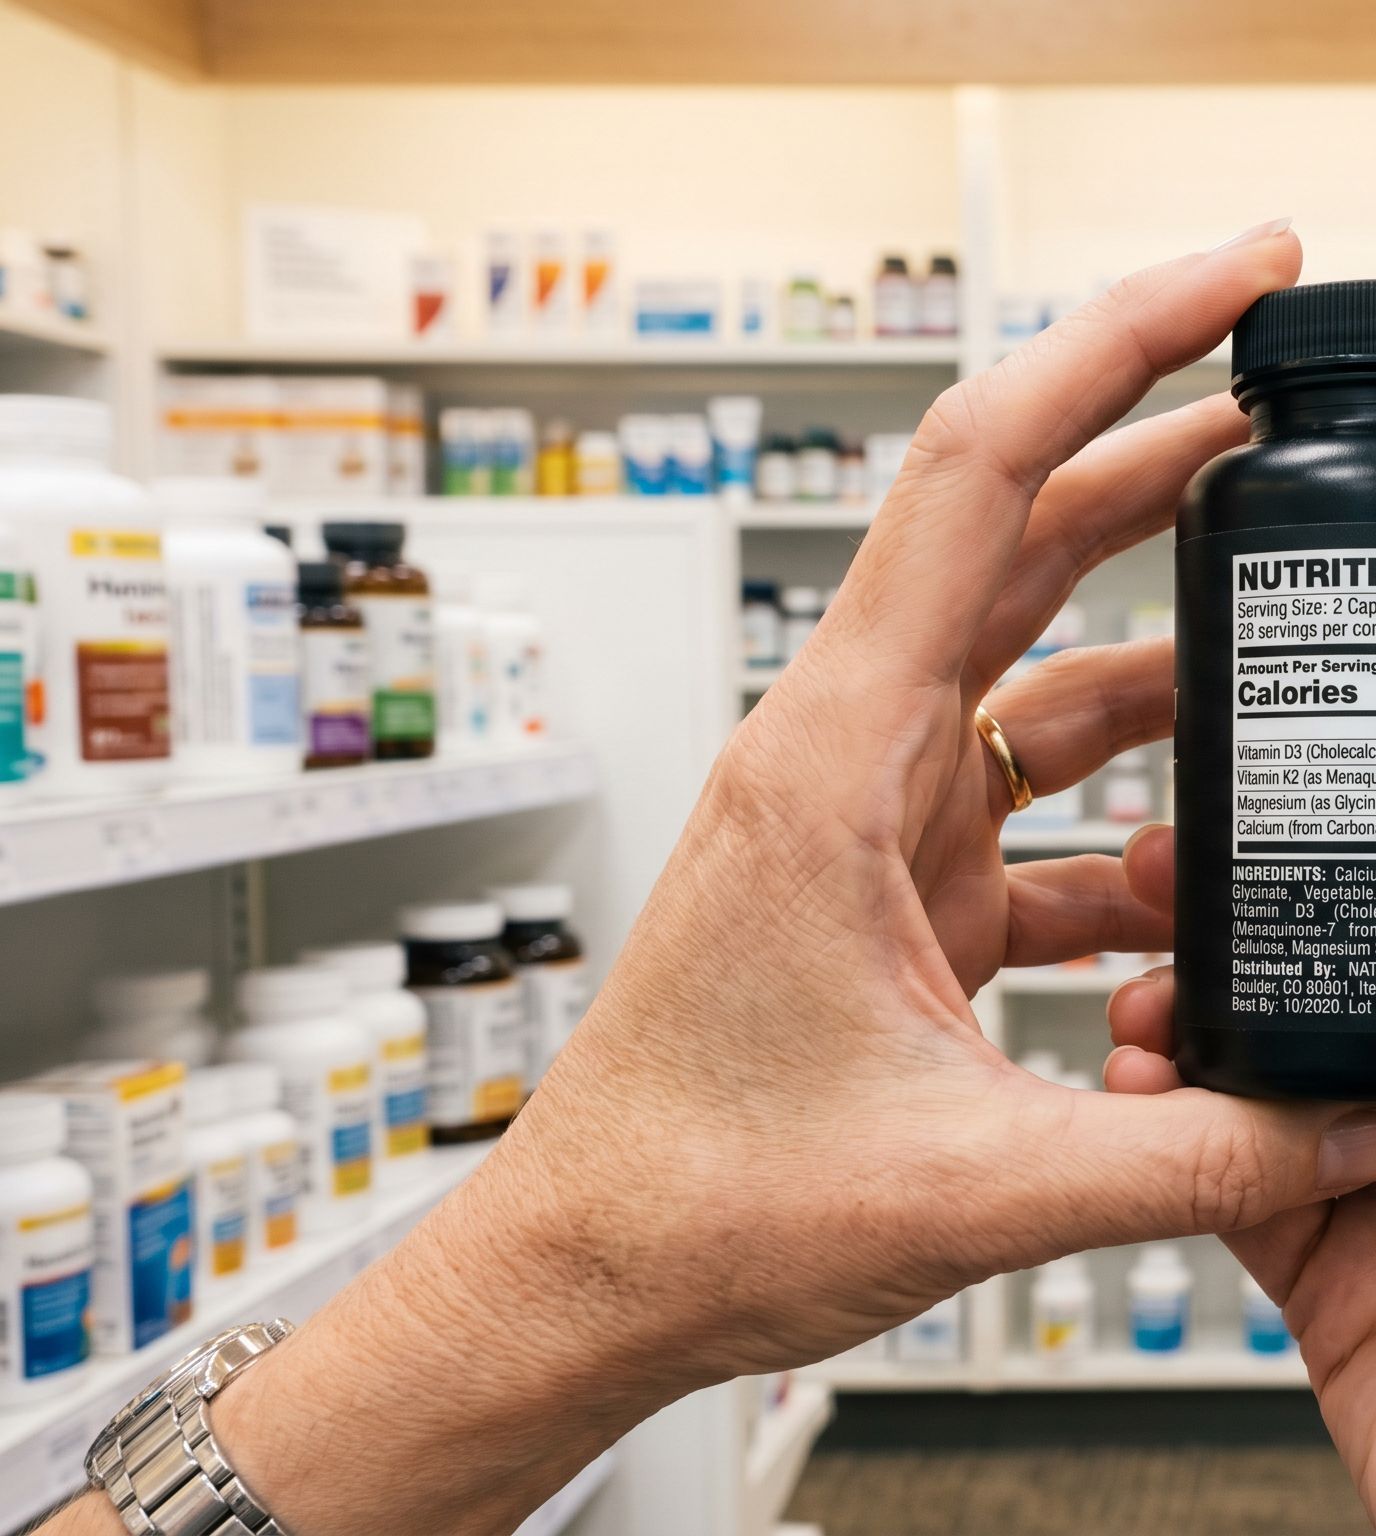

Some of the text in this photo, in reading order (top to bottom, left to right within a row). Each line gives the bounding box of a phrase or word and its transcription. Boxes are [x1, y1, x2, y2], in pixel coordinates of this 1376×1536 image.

[1238, 600, 1287, 620] Serving
[1292, 598, 1327, 616] Size:
[1333, 598, 1342, 614] 2
[1238, 622, 1254, 640] 28
[1258, 624, 1317, 641] servings
[1323, 623, 1348, 641] per
[1237, 661, 1288, 675] Amount
[1293, 660, 1317, 673] Per
[1238, 679, 1358, 707] Calories
[1237, 744, 1280, 760] Vitamin
[1285, 744, 1302, 759] D3
[1237, 769, 1279, 785] Vitamin
[1283, 769, 1299, 784] K2
[1303, 769, 1322, 789] (as
[1237, 795, 1306, 814] Magnesium
[1311, 795, 1331, 814] (as
[1237, 819, 1284, 835] Calcium
[1288, 819, 1322, 839] (from
[1233, 866, 1326, 881] INGREDIENTS:
[1232, 884, 1291, 902] Glycinate,
[1232, 902, 1279, 918] Vitamin
[1296, 903, 1314, 918] D3
[1232, 921, 1336, 939] (Menaquinone-7
[1232, 938, 1288, 957] Cellulose,
[1292, 940, 1370, 958] Magnesium
[1233, 960, 1302, 976] Distributed
[1314, 961, 1336, 980] By:
[1232, 978, 1279, 996] Boulder,
[1283, 979, 1302, 995] CO
[1232, 996, 1256, 1012] Best
[1259, 997, 1278, 1015] By:
[1284, 998, 1343, 1014] 10/2020.
[1349, 999, 1372, 1014] Lot
